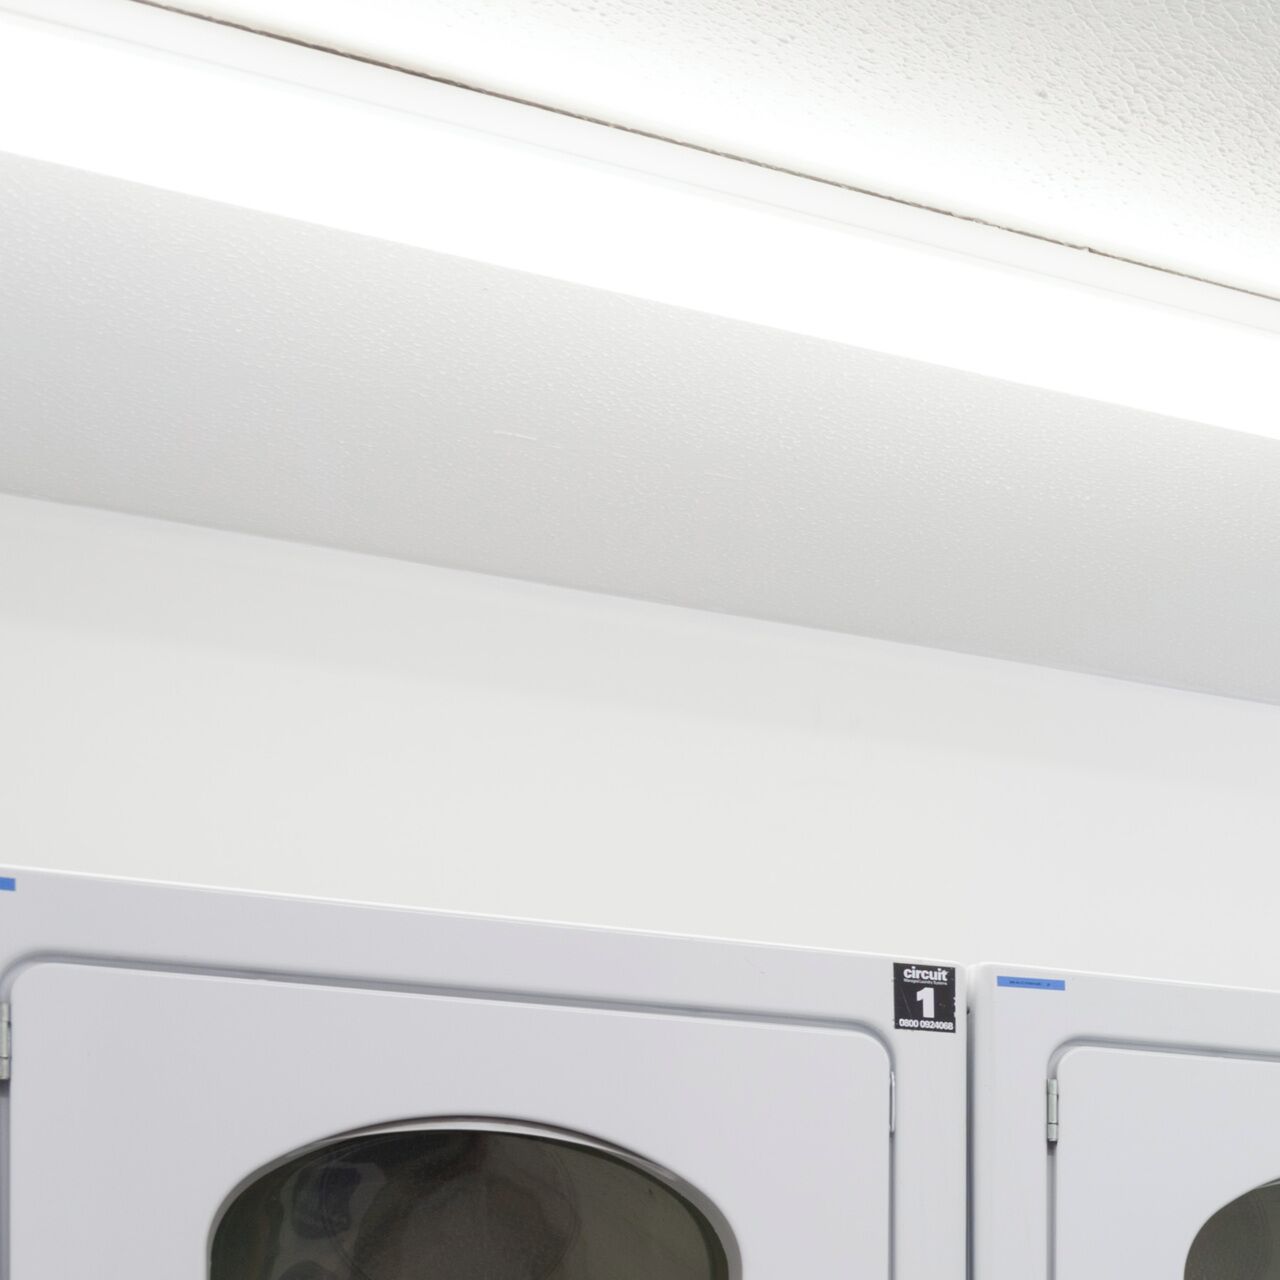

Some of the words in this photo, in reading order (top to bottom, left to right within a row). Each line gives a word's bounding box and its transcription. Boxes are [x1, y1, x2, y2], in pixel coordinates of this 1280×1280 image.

[904, 966, 947, 981] circuit
[916, 987, 934, 1018] 1
[899, 1018, 918, 1028] 0800
[920, 1020, 953, 1031] 0924068
